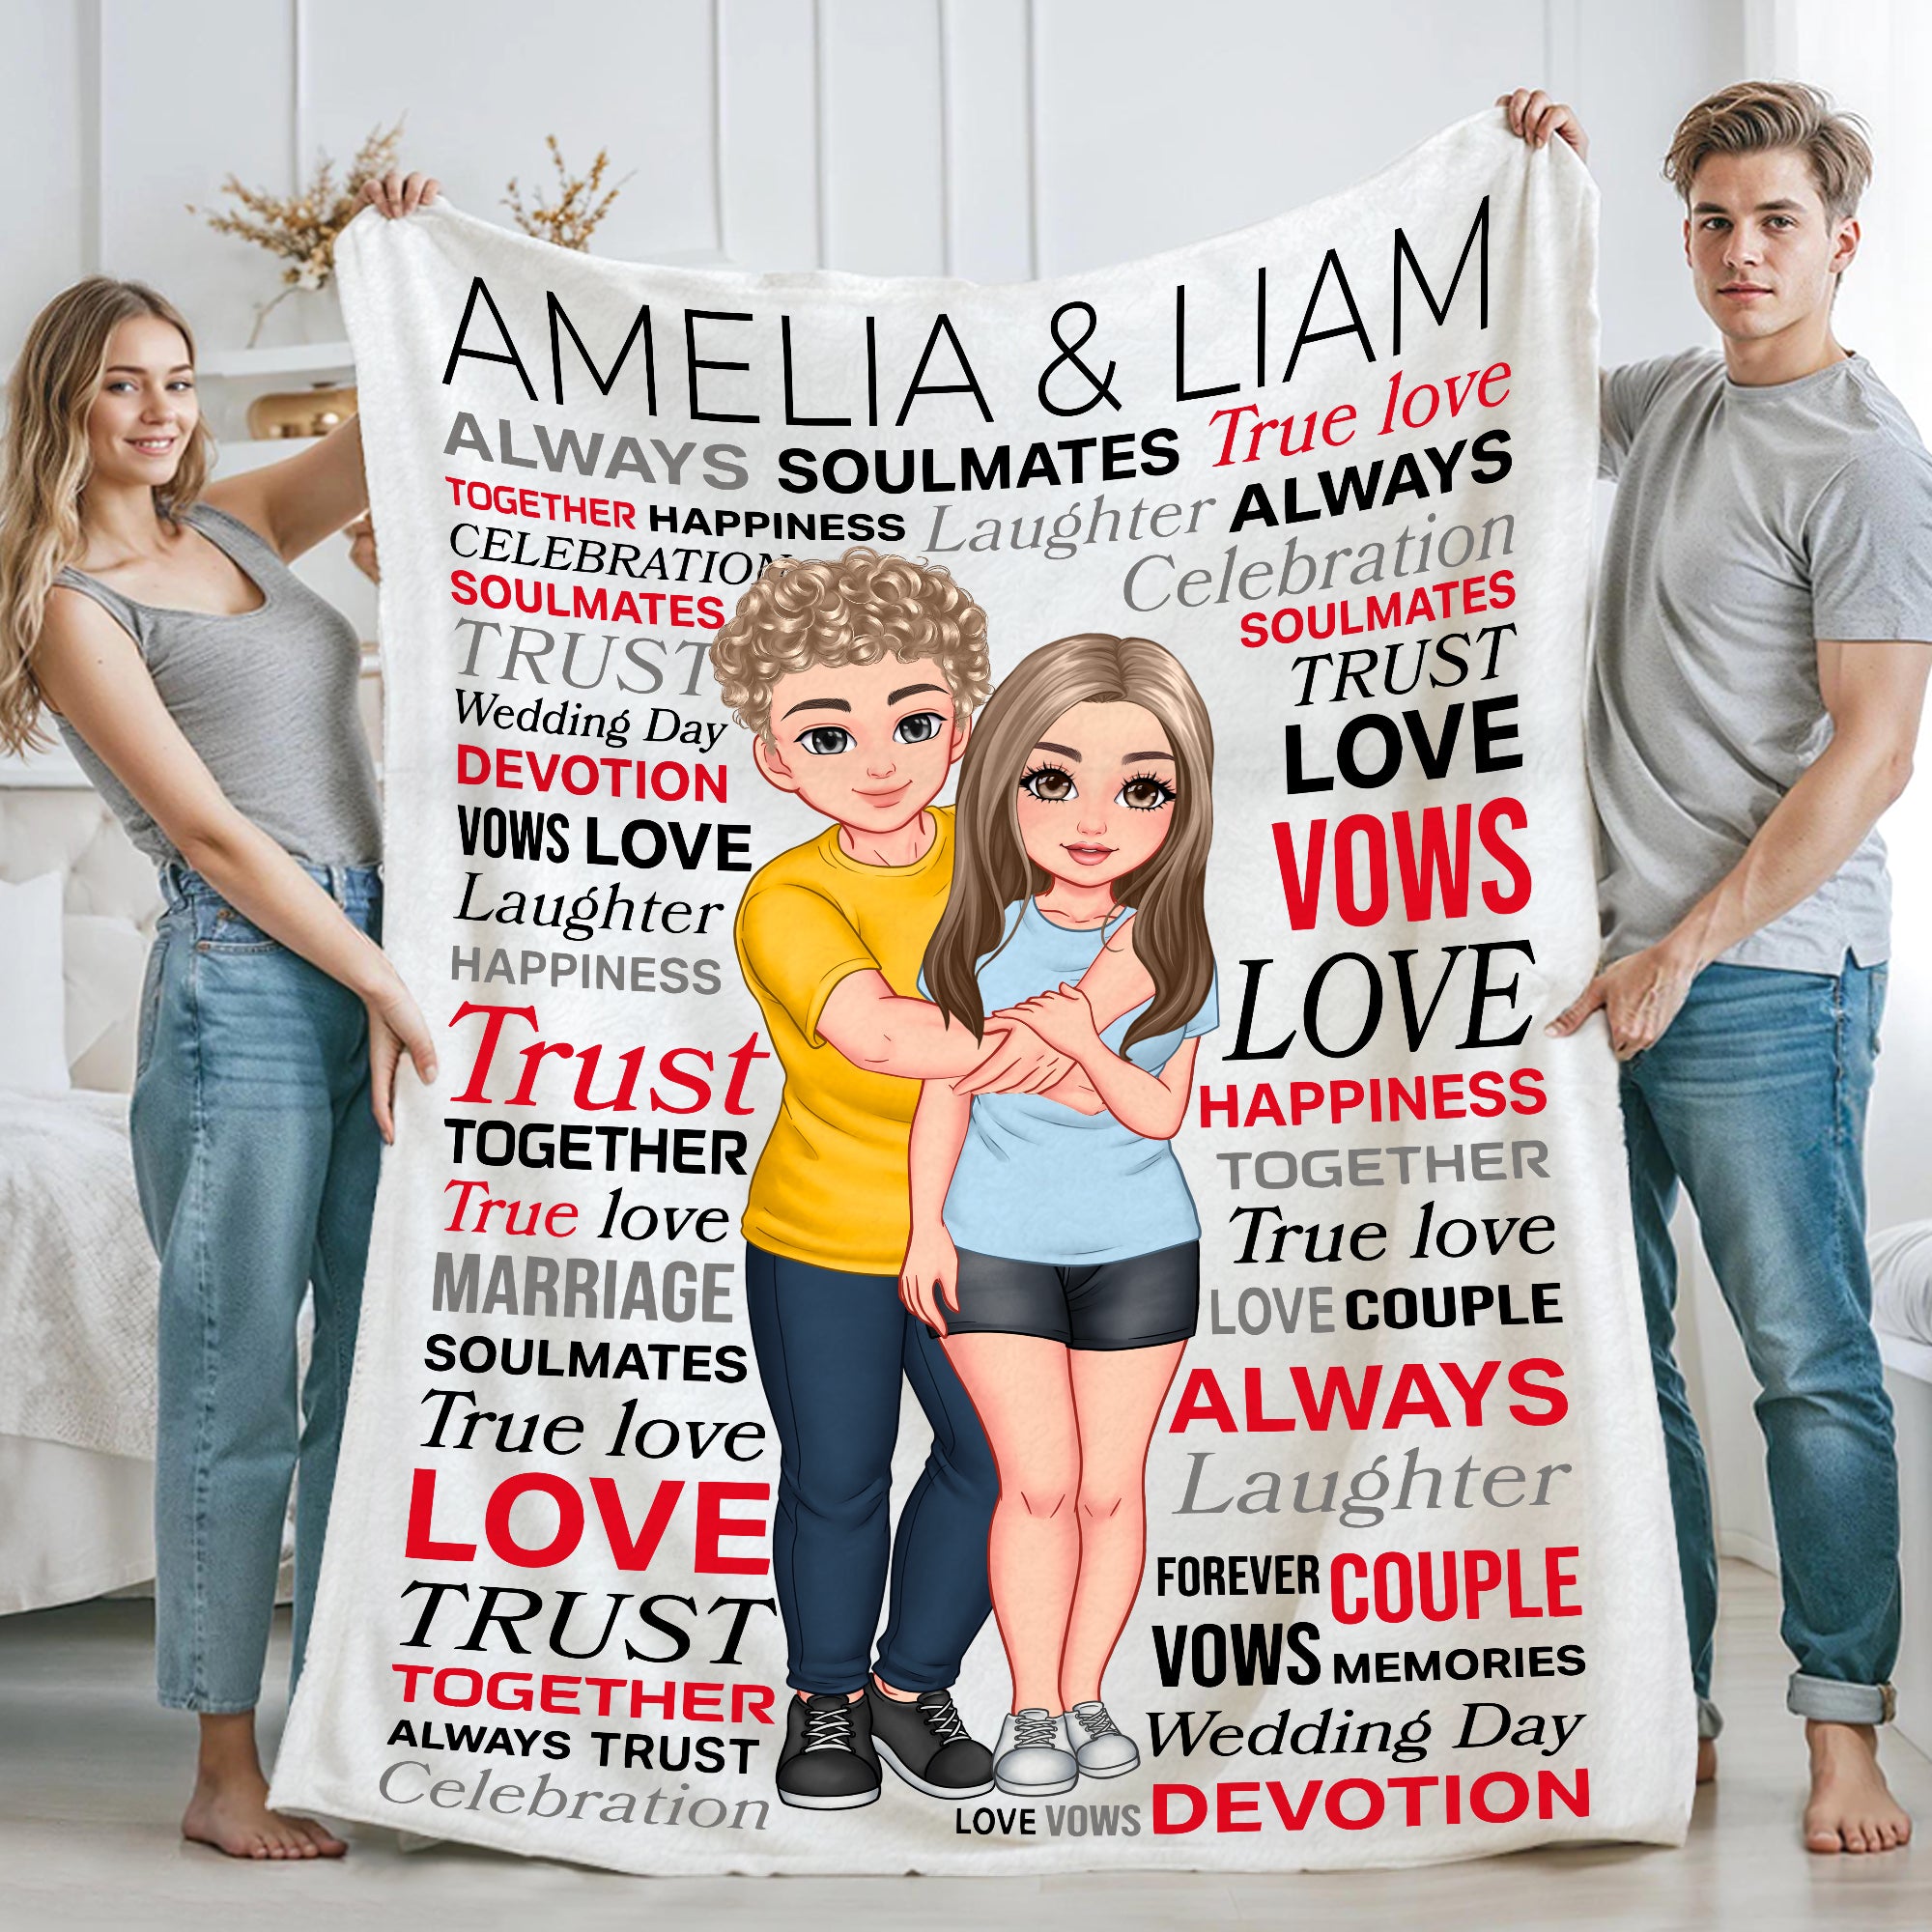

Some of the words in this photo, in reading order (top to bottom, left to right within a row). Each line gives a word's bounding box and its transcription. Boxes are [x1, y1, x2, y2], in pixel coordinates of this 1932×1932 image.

[442, 276, 994, 426] AMELIA
[1038, 301, 1122, 416] &
[1177, 195, 1490, 402] LIAM
[443, 412, 748, 490] ALWAYS
[779, 428, 1179, 494] SOULMATES
[1208, 404, 1356, 467] True
[1378, 362, 1511, 435] love
[445, 476, 636, 529] TOGETHER
[650, 505, 905, 541] HAPPINESS
[922, 495, 1216, 559] Laughter
[1229, 429, 1513, 532] ALWAYS
[1123, 514, 1515, 612] Celebration
[451, 570, 725, 630] SOULMATES
[1240, 569, 1516, 648] SOULMATES
[455, 617, 713, 696] TRUST
[1292, 622, 1517, 706] TRUST
[456, 689, 630, 748] Wedding
[642, 708, 728, 753] Day
[1286, 694, 1523, 795] LOVE
[458, 744, 726, 803] DEVOTION
[457, 805, 569, 864] VOWS
[587, 817, 752, 871] LOVE
[1271, 797, 1532, 930] VOWS
[453, 872, 724, 941] Laughter
[452, 946, 721, 995] HAPPINESS
[1222, 940, 1535, 1061] LOVE
[448, 1001, 770, 1115] Trust
[1200, 1068, 1547, 1128] HAPPINESS
[444, 1119, 748, 1175] TOGETHER
[1216, 1140, 1550, 1189] TOGETHER
[444, 1179, 578, 1237] True
[597, 1187, 729, 1242] love
[1229, 1206, 1386, 1264] True
[1409, 1201, 1555, 1259] love
[433, 1252, 734, 1322] MARRIAGE
[1211, 1287, 1335, 1335] LOVE
[1346, 1283, 1563, 1330] COUPLE
[424, 1334, 747, 1383] SOULMATES
[420, 1388, 583, 1455] True
[605, 1399, 765, 1462] love
[1169, 1358, 1568, 1434] ALWAYS
[405, 1468, 770, 1575] LOVE
[1172, 1447, 1572, 1528] Laughter
[1157, 1554, 1320, 1598] FOREVER
[1330, 1547, 1582, 1625] COUPLE
[400, 1580, 777, 1664] TRUST
[1151, 1622, 1321, 1688] VOWS
[1334, 1644, 1585, 1684] MEMORIES
[392, 1663, 775, 1724] TOGETHER
[386, 1719, 570, 1760] ALWAYS
[591, 1732, 759, 1774] TRUST
[1146, 1708, 1432, 1763] Wedding
[1451, 1703, 1587, 1756] Day
[380, 1761, 769, 1830] Celebration
[956, 1807, 1036, 1837] LOVE
[1045, 1804, 1141, 1836] VOWS
[1152, 1768, 1589, 1834] DEVOTION
